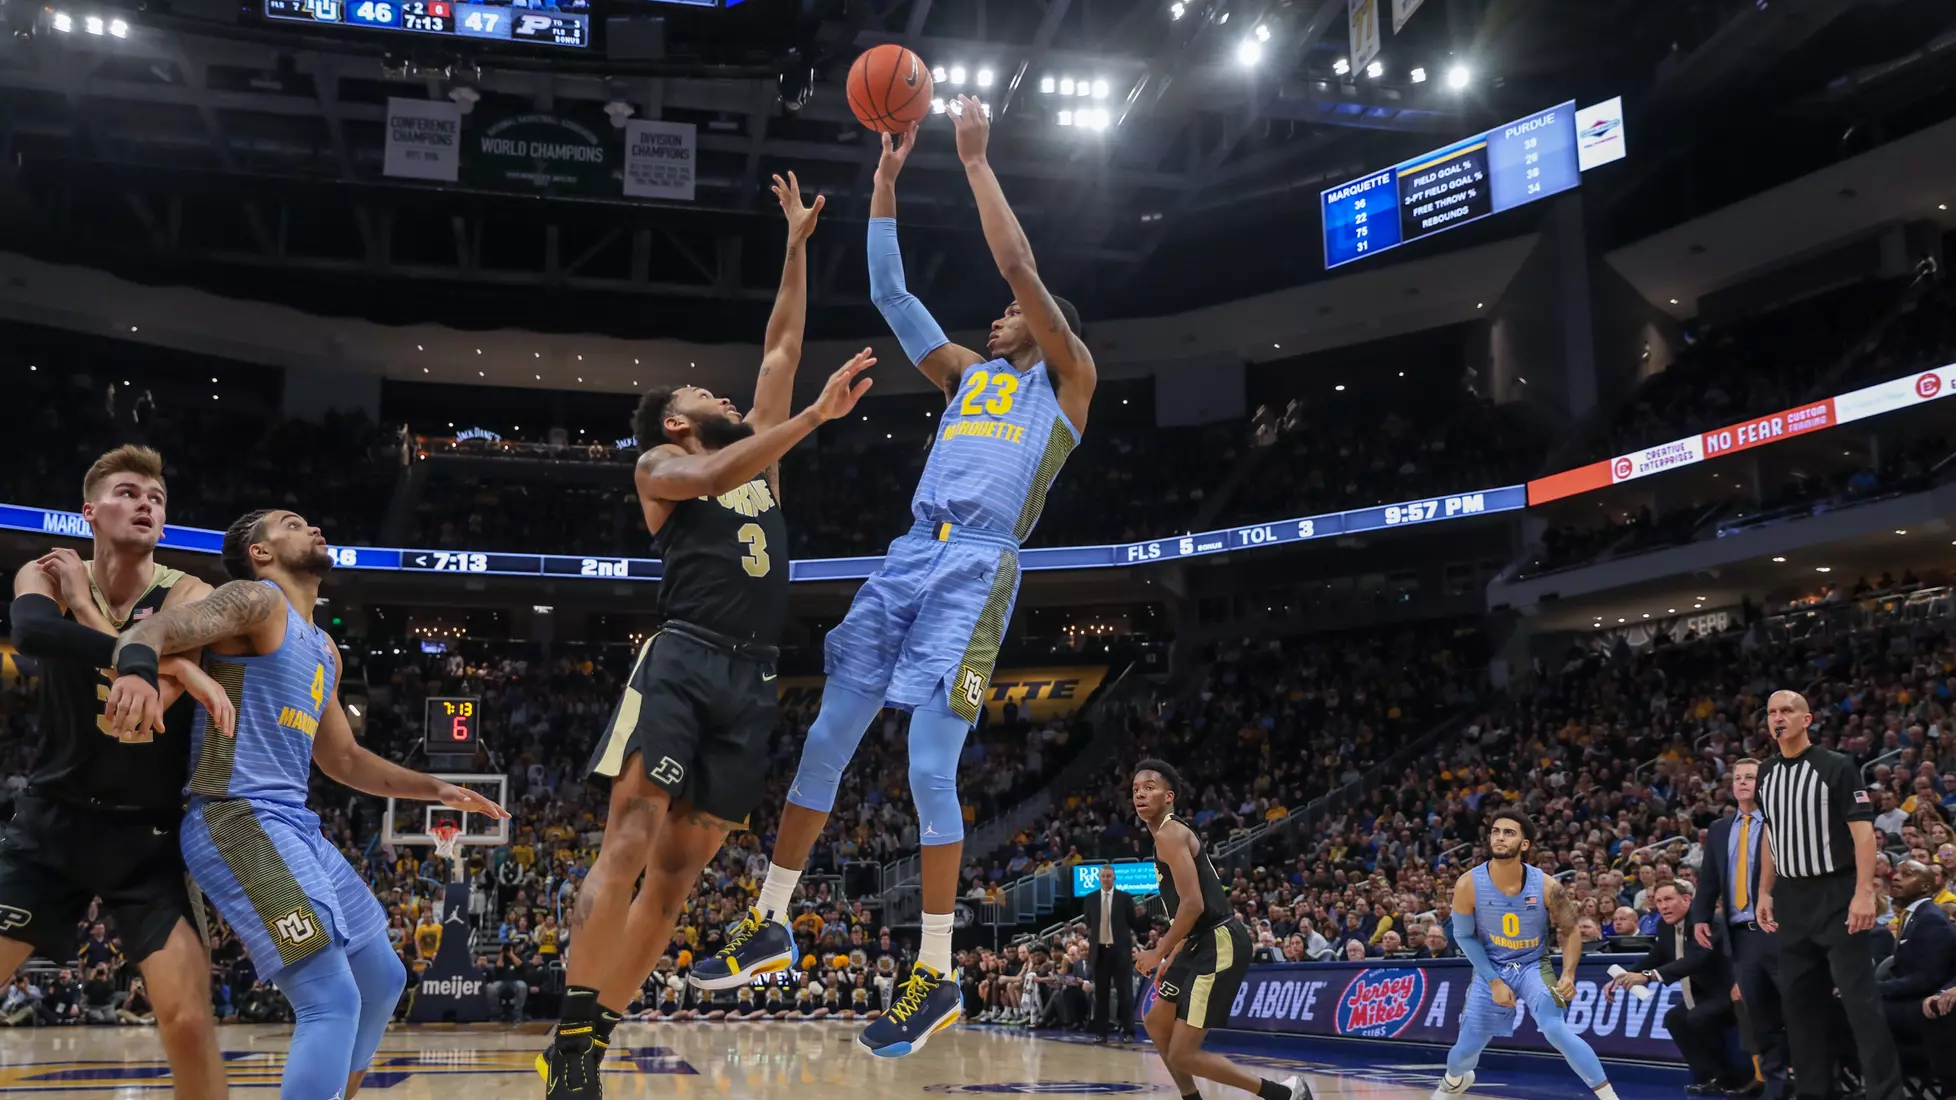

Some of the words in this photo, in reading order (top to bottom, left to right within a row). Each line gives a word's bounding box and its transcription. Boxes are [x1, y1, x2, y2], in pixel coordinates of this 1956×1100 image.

[357, 1, 392, 22] 46
[413, 2, 424, 14] 2
[404, 14, 444, 31] 7:13
[465, 12, 499, 32] 47
[555, 36, 580, 45] BONUS
[391, 116, 457, 133] CONFERENCE
[1505, 112, 1556, 140] PURDUE
[393, 129, 453, 146] CHAMPIONS
[640, 132, 682, 147] DIVISION
[481, 136, 527, 157] WORLD
[530, 142, 604, 163] CHAMPIONS
[632, 144, 690, 160] CHAMPIONS
[1413, 173, 1436, 187] FIELD
[1437, 164, 1462, 179] GOAL
[1462, 160, 1472, 170] %
[1328, 172, 1390, 204] MARQUETTE
[1404, 191, 1423, 205] 3-PT
[1425, 183, 1448, 198] FIELD
[1449, 175, 1473, 189] GOAL
[1474, 171, 1483, 181] %
[1527, 182, 1541, 195] 34
[1413, 203, 1434, 217] FREE
[1434, 191, 1467, 209] THROW
[1467, 188, 1477, 198] %
[1355, 212, 1367, 224] 22
[1422, 205, 1469, 228] REBOUNDS
[1356, 226, 1368, 238] 75
[1357, 240, 1368, 252] 31
[961, 371, 1019, 415] 23
[1787, 404, 1827, 423] CUSTOM
[942, 420, 1025, 444] MARQUETTE
[1707, 430, 1732, 454] NO
[1738, 416, 1783, 447] FEAR
[1640, 451, 1694, 472] ENTERPRISES
[1645, 443, 1685, 461] CREATIVE
[1385, 501, 1438, 525] 9:57
[1445, 493, 1485, 516] PM
[1239, 526, 1277, 545] TOL
[1298, 520, 1314, 538] 3
[737, 523, 771, 577] 3
[1128, 542, 1161, 561] FLS
[1179, 538, 1194, 555] 5
[1197, 542, 1223, 552] BONUS
[433, 552, 488, 573] 7:13
[581, 559, 628, 577] 2nd
[311, 664, 324, 712] 4
[962, 667, 985, 706] MU
[443, 701, 473, 717] 7:13
[453, 716, 468, 740] 6
[651, 756, 684, 784] P
[273, 908, 317, 945] MU
[1502, 913, 1520, 937] 0
[422, 976, 483, 999] meijer
[1159, 981, 1180, 997] P
[1347, 974, 1415, 1008] Jersey
[1247, 980, 1323, 1021] ABOVE
[1424, 981, 1450, 1027] A
[1563, 980, 1684, 1040] BOVE
[1346, 998, 1410, 1032] Mike's
